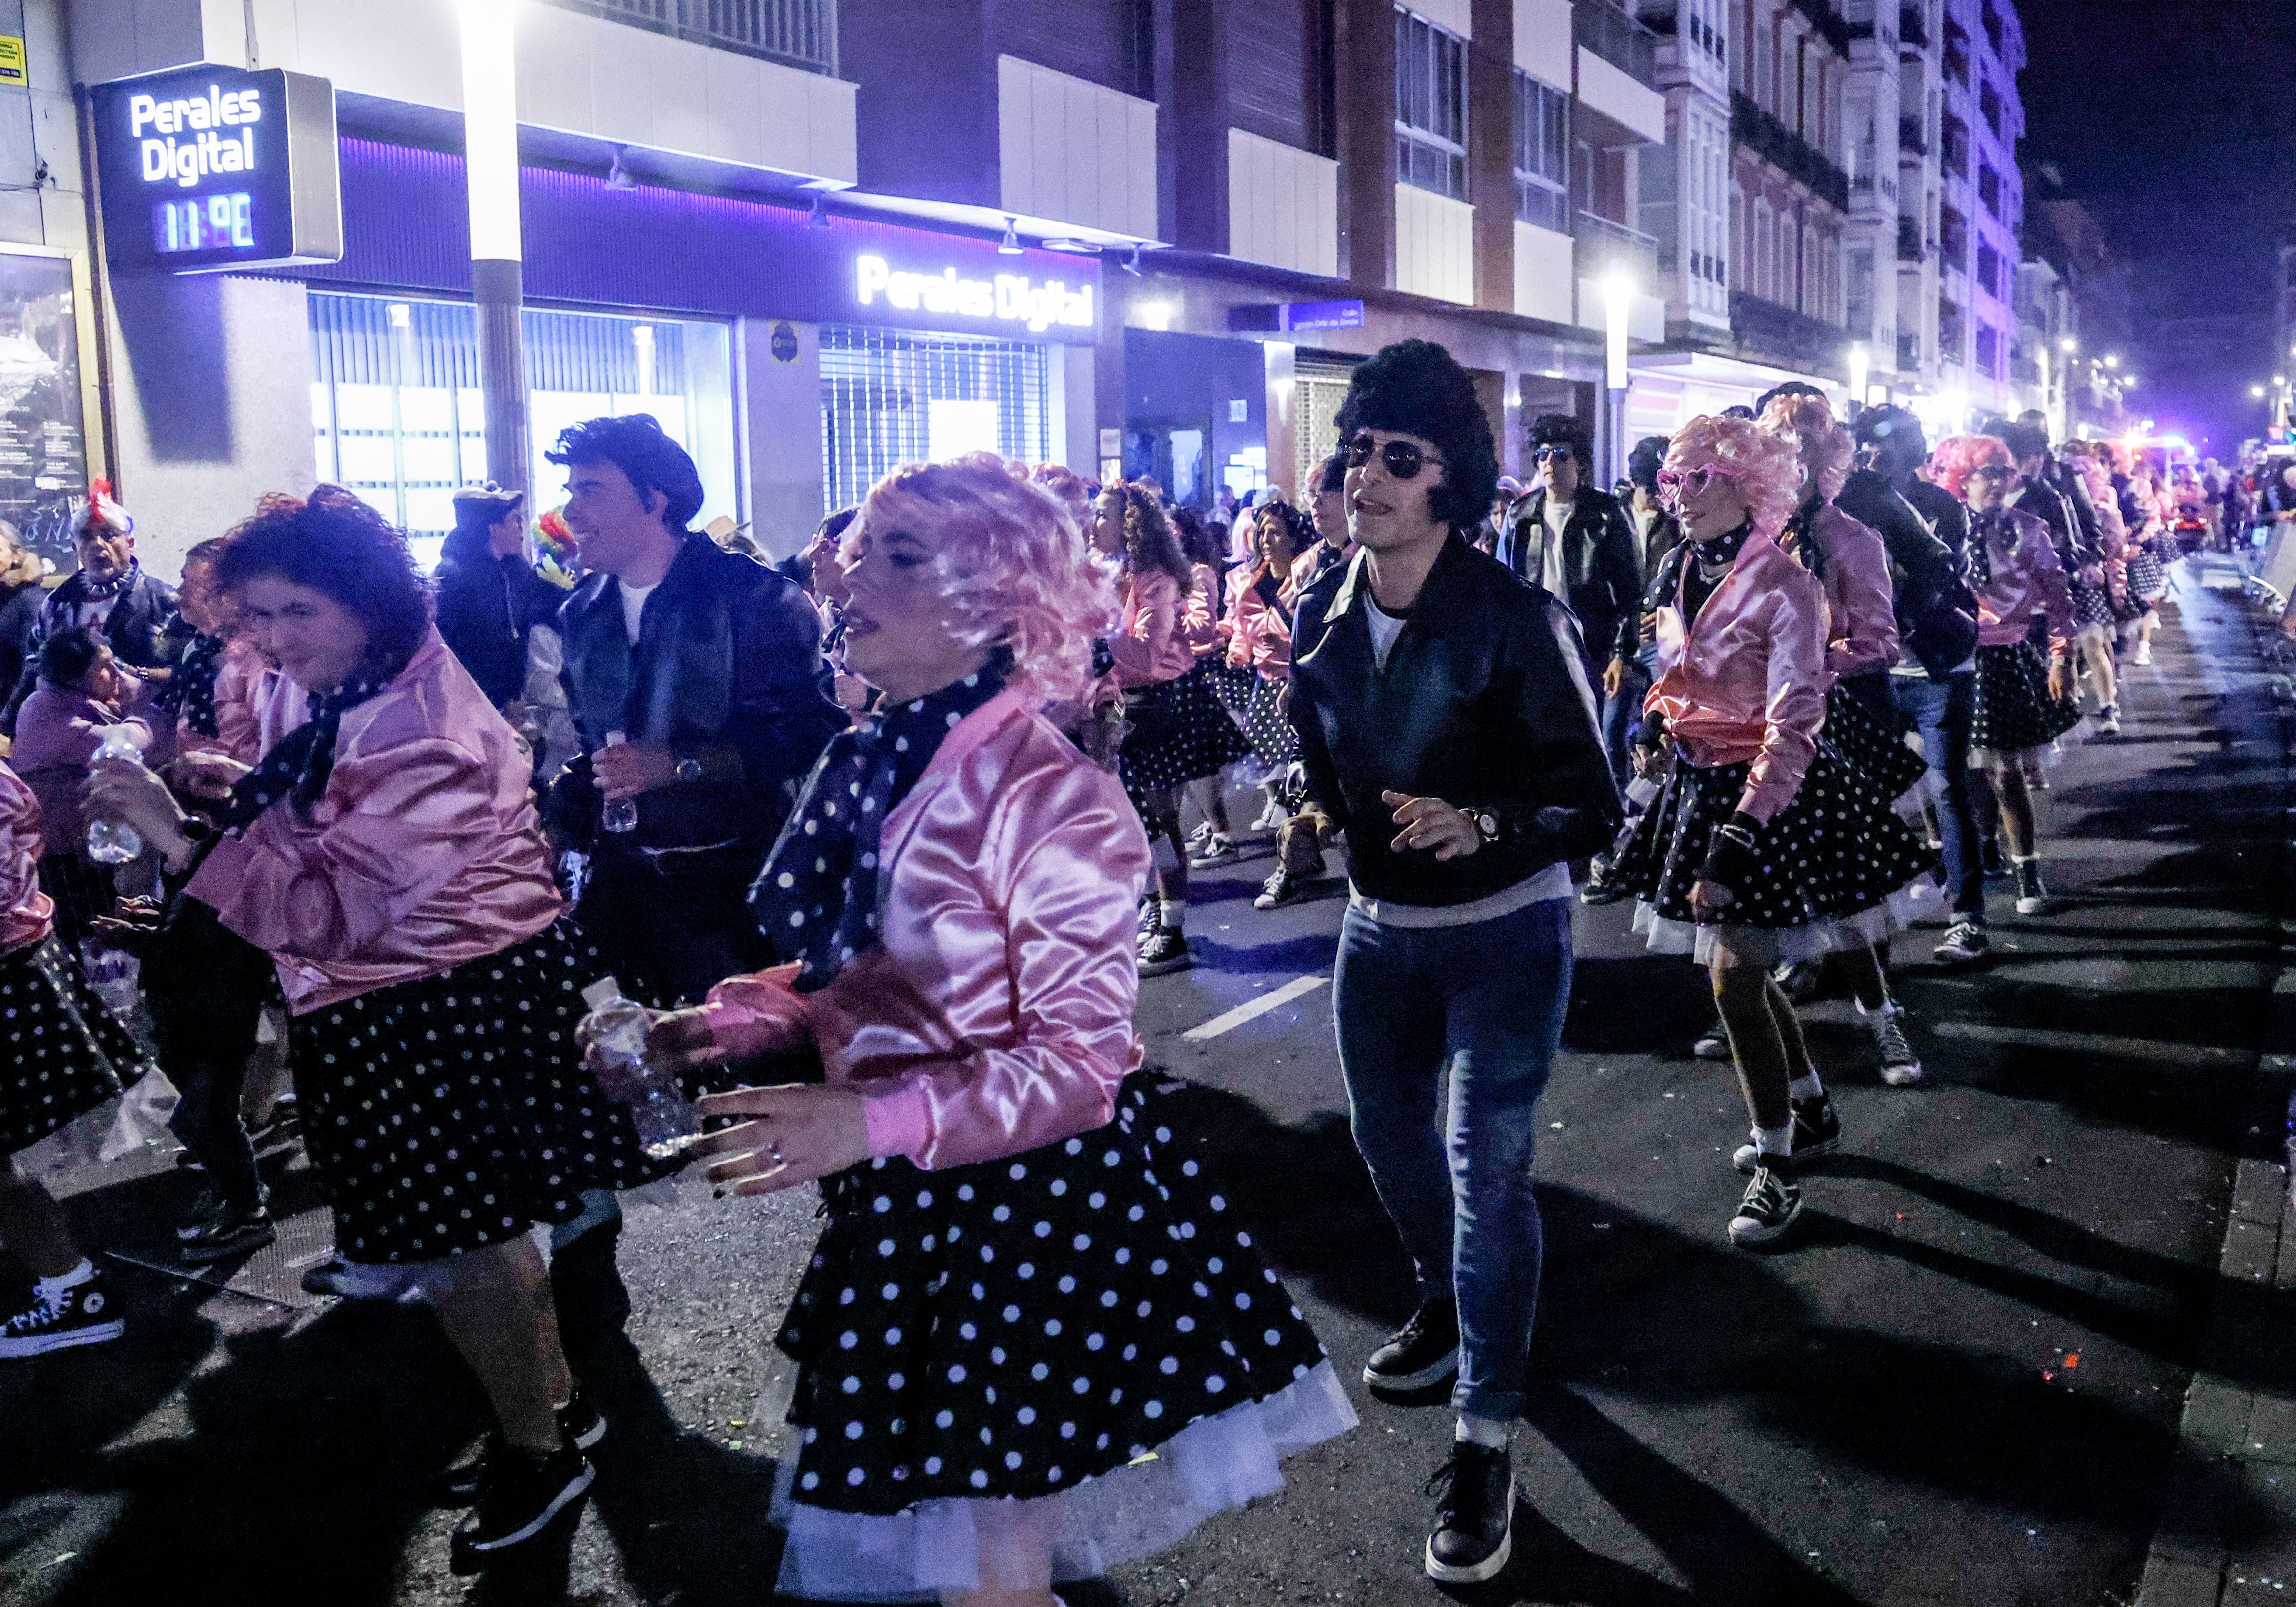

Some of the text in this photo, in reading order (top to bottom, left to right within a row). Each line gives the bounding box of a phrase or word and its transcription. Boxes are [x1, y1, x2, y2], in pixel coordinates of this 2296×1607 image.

[131, 85, 261, 137] Perales
[142, 127, 254, 187] Digital
[858, 255, 1092, 332] Perales Digital
